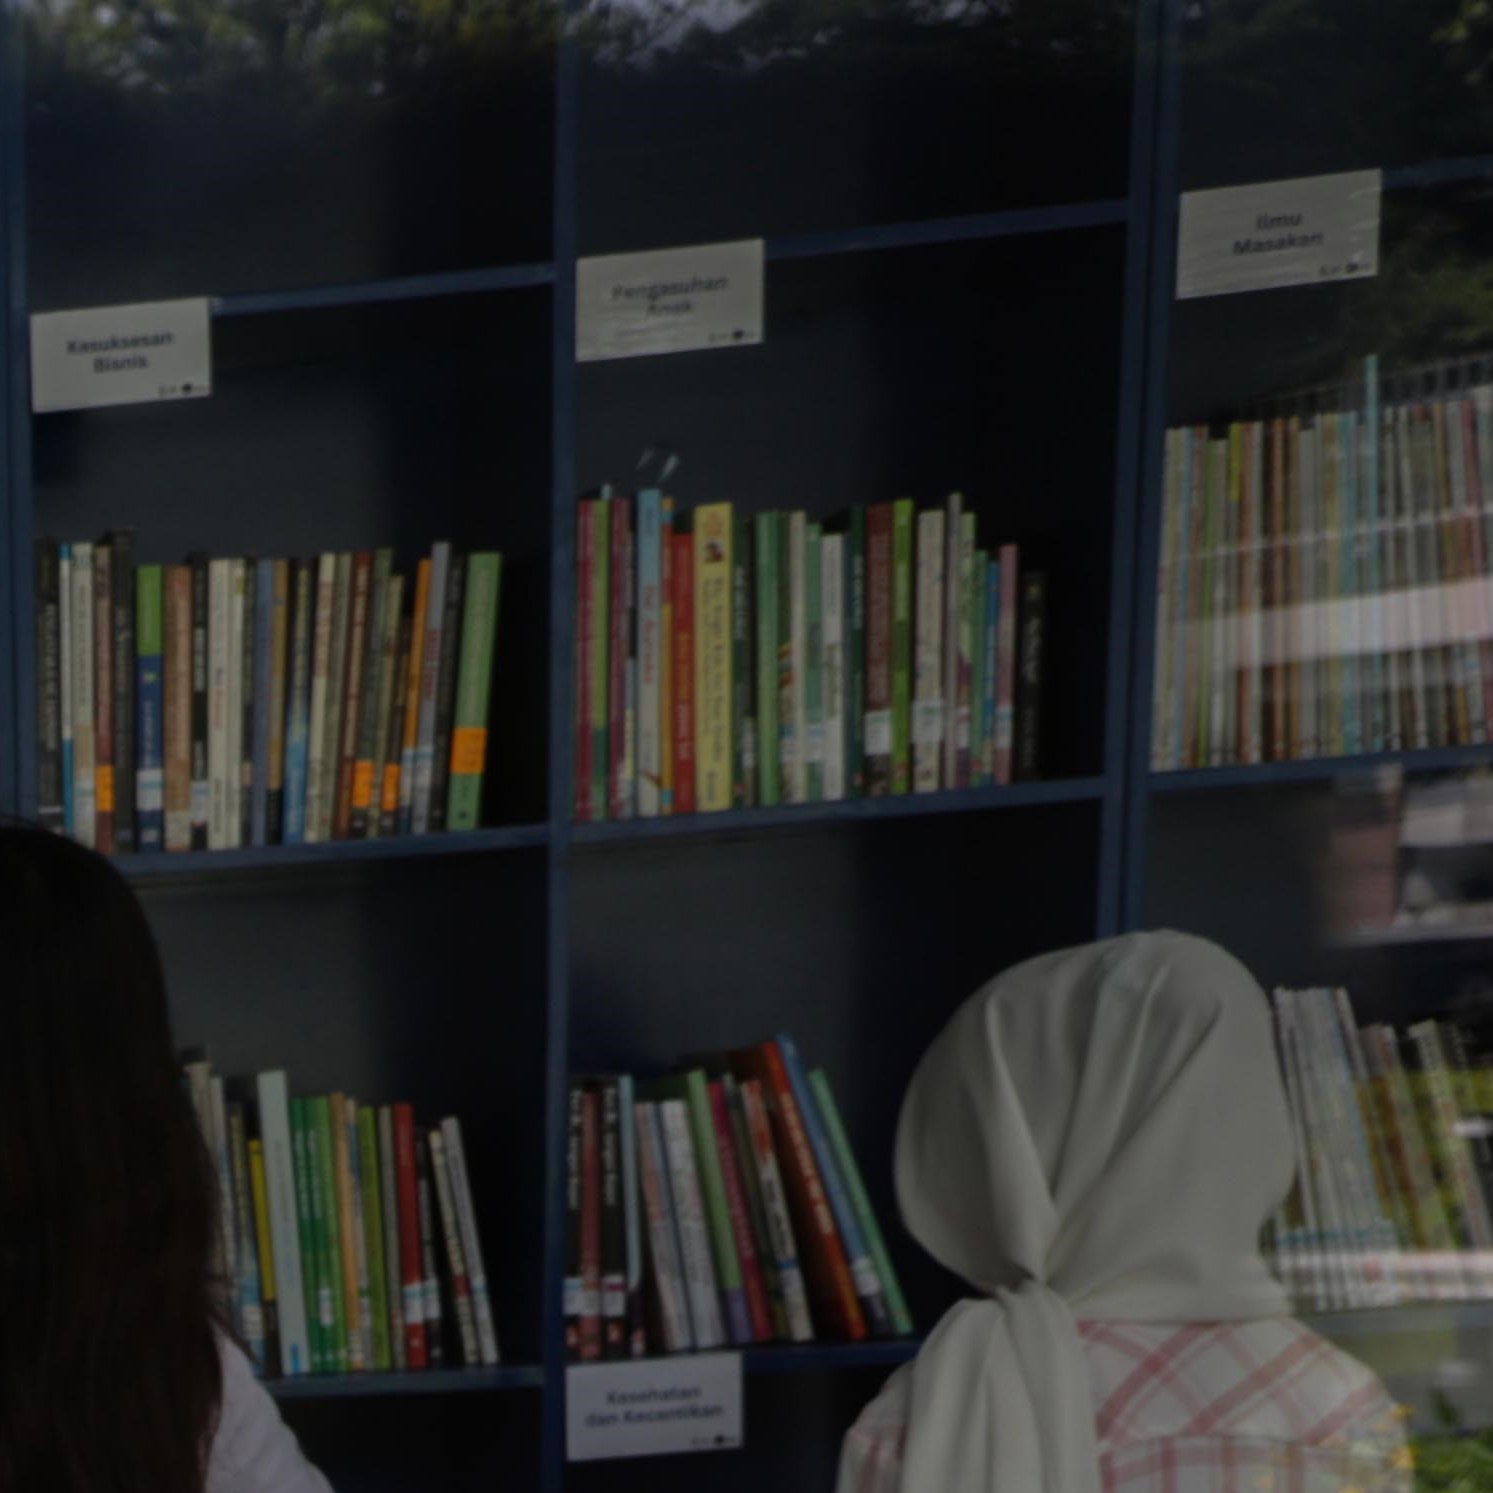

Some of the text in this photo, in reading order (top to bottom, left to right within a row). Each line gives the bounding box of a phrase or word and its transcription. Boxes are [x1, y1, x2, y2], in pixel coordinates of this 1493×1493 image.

[1233, 229, 1324, 256] Masakan
[67, 331, 173, 354] Kesuksesan
[93, 355, 148, 373] Bisnis
[606, 1385, 701, 1405] Kesehatan
[585, 1403, 724, 1428] dan Kecantikan
